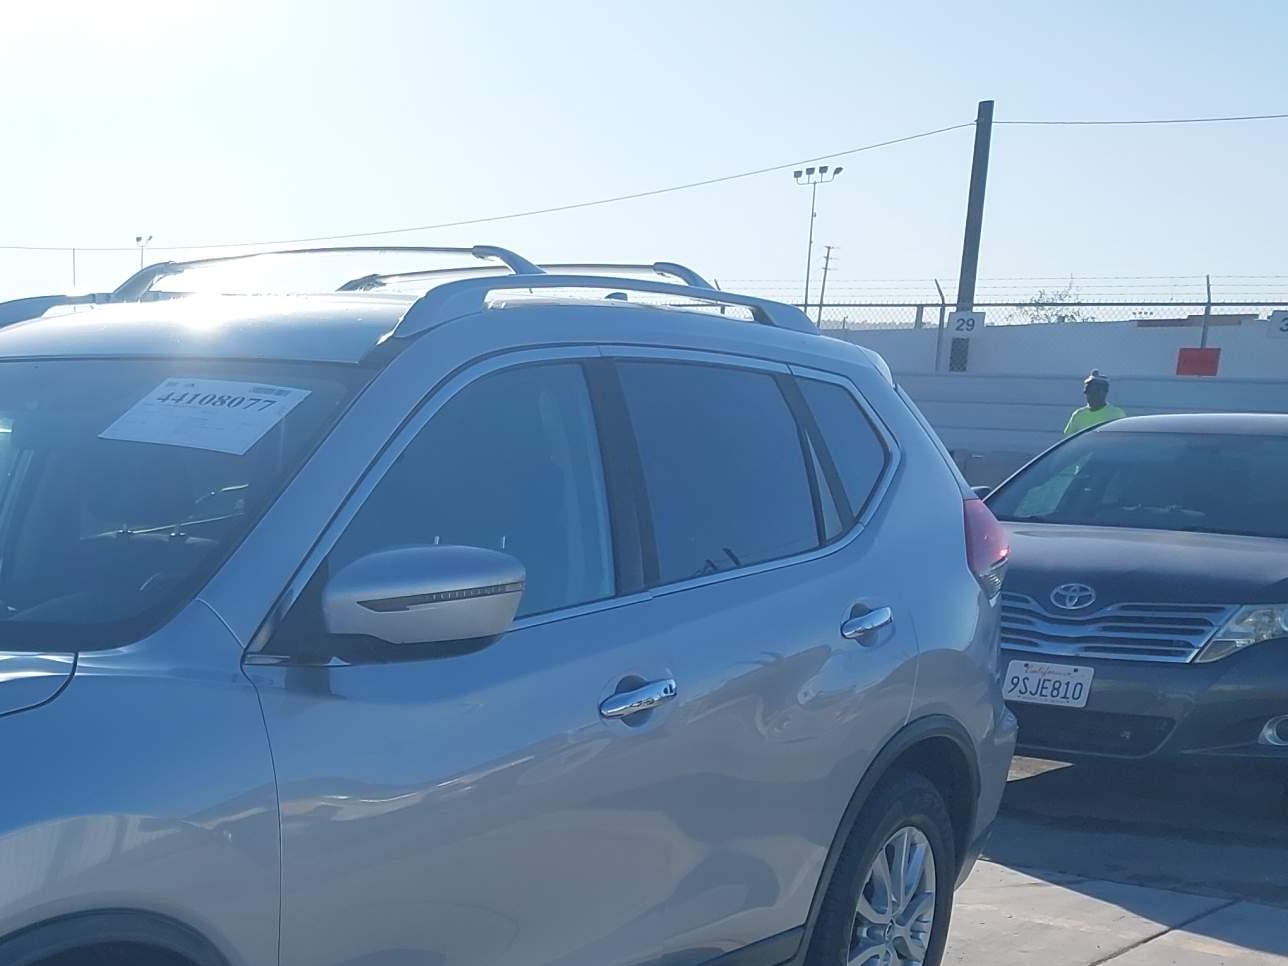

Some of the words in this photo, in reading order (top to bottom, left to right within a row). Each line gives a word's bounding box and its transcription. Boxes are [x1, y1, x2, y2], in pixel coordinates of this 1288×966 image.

[955, 318, 975, 331] 29
[157, 391, 277, 412] 44108077
[1008, 675, 1083, 701] 9SJE810
